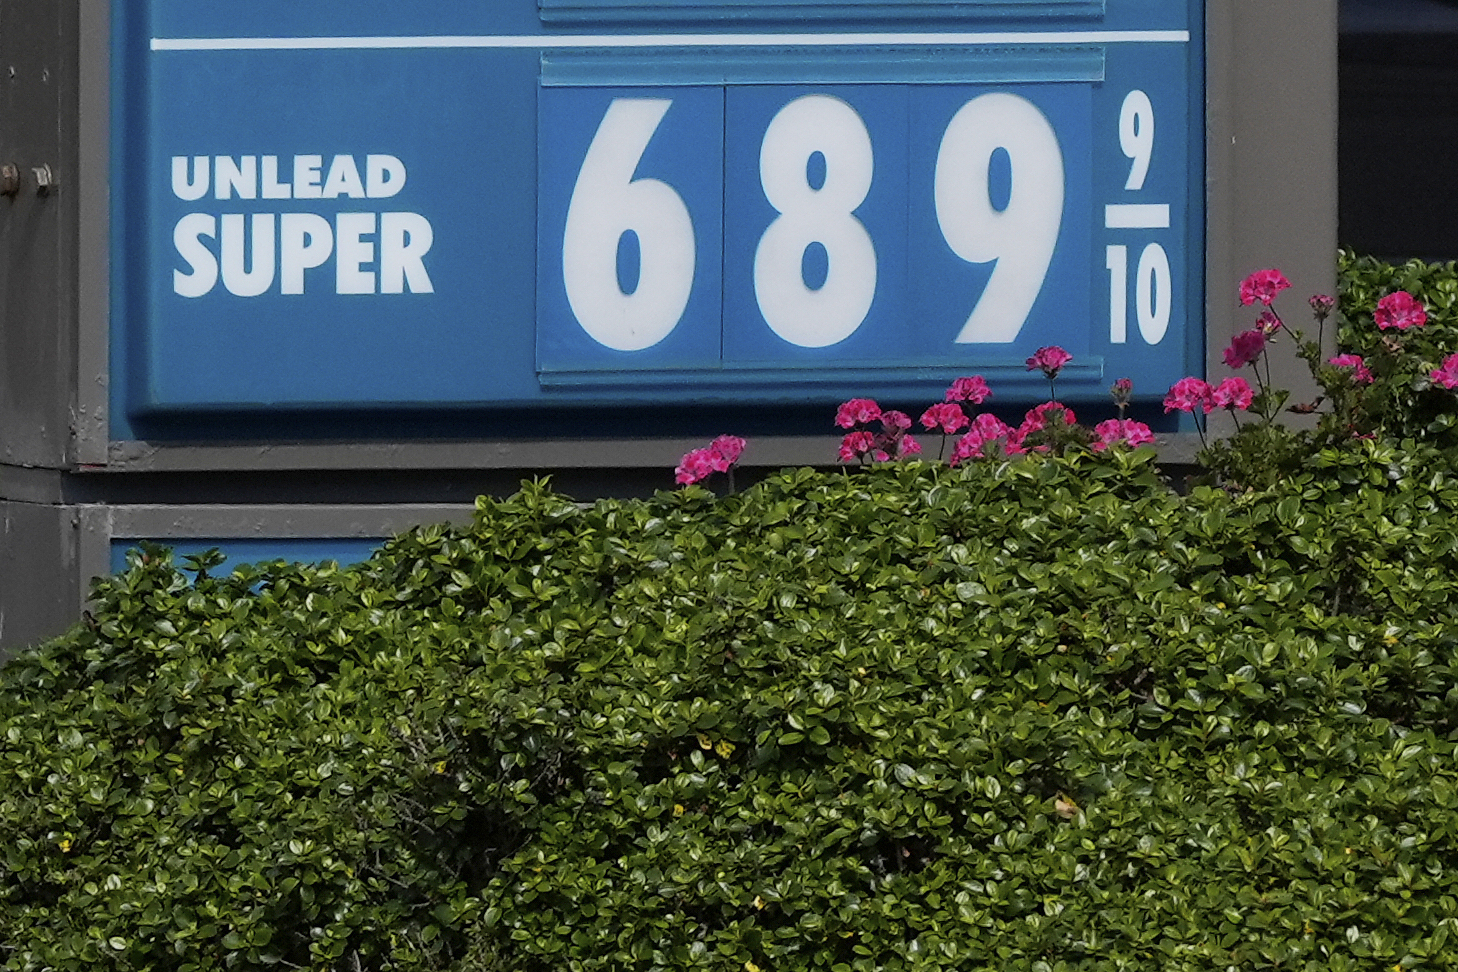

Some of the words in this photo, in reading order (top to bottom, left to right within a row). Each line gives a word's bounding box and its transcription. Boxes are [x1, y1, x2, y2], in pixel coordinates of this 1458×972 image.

[171, 154, 406, 201] UNLEAD
[173, 211, 434, 298] SUPER
[563, 93, 1064, 351] 689
